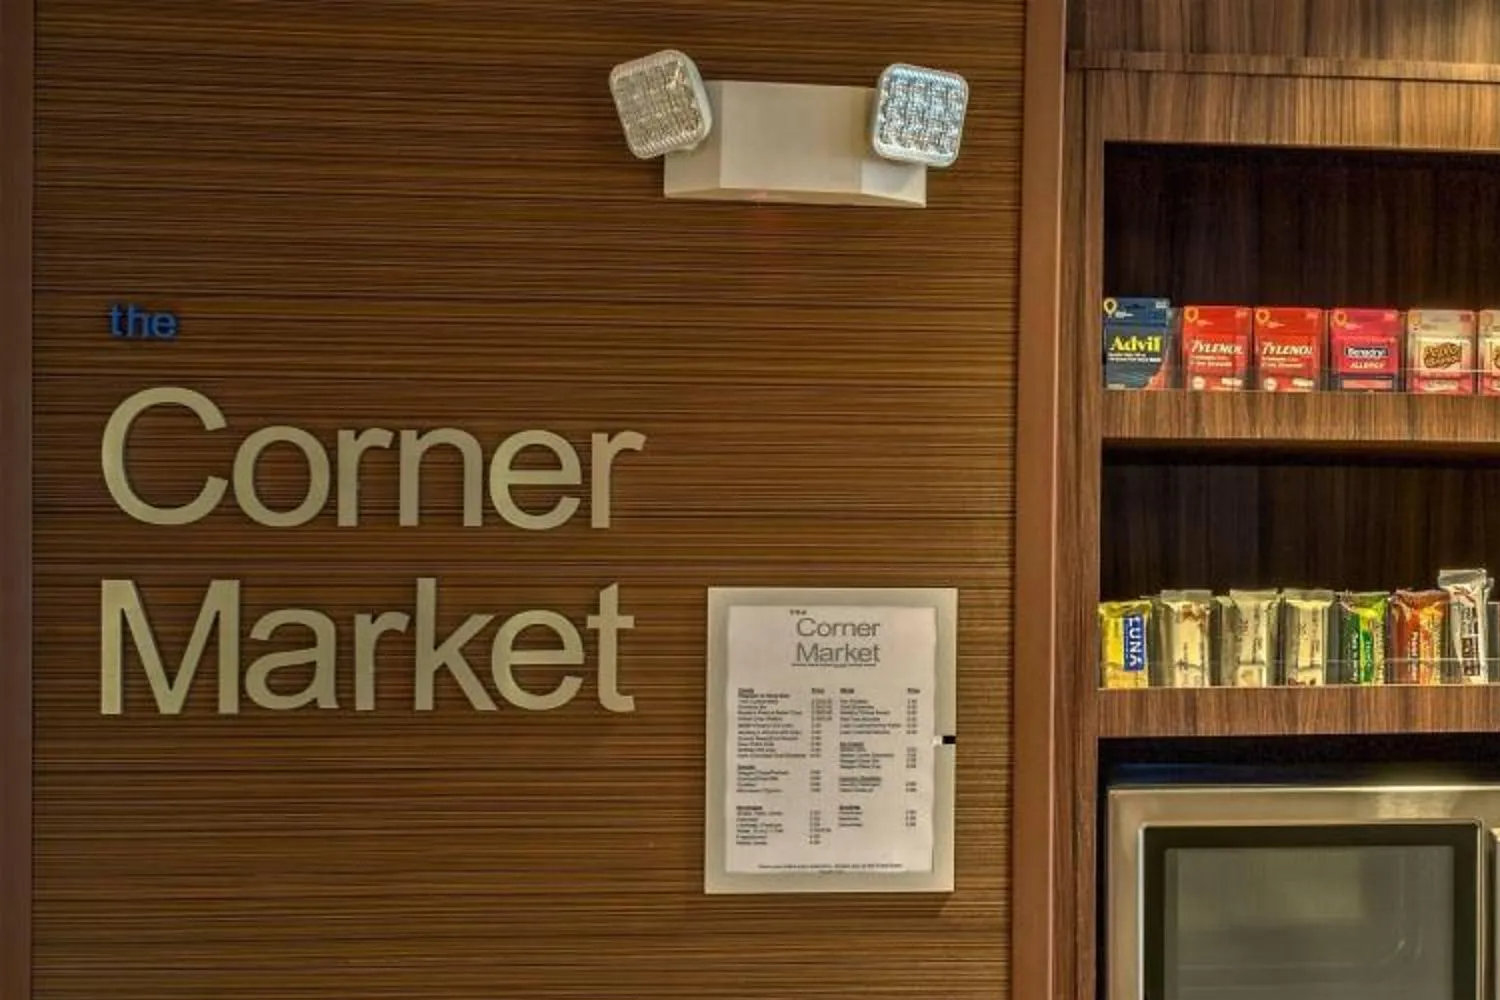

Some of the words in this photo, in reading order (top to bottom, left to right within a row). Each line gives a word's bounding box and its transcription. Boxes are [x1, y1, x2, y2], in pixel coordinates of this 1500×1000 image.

[109, 303, 179, 339] the
[1109, 336, 1162, 352] Advil
[101, 386, 647, 530] Corner
[796, 617, 881, 637] Corner
[1128, 616, 1142, 667] LUNA
[100, 577, 636, 715] Market
[797, 642, 880, 662] Market
